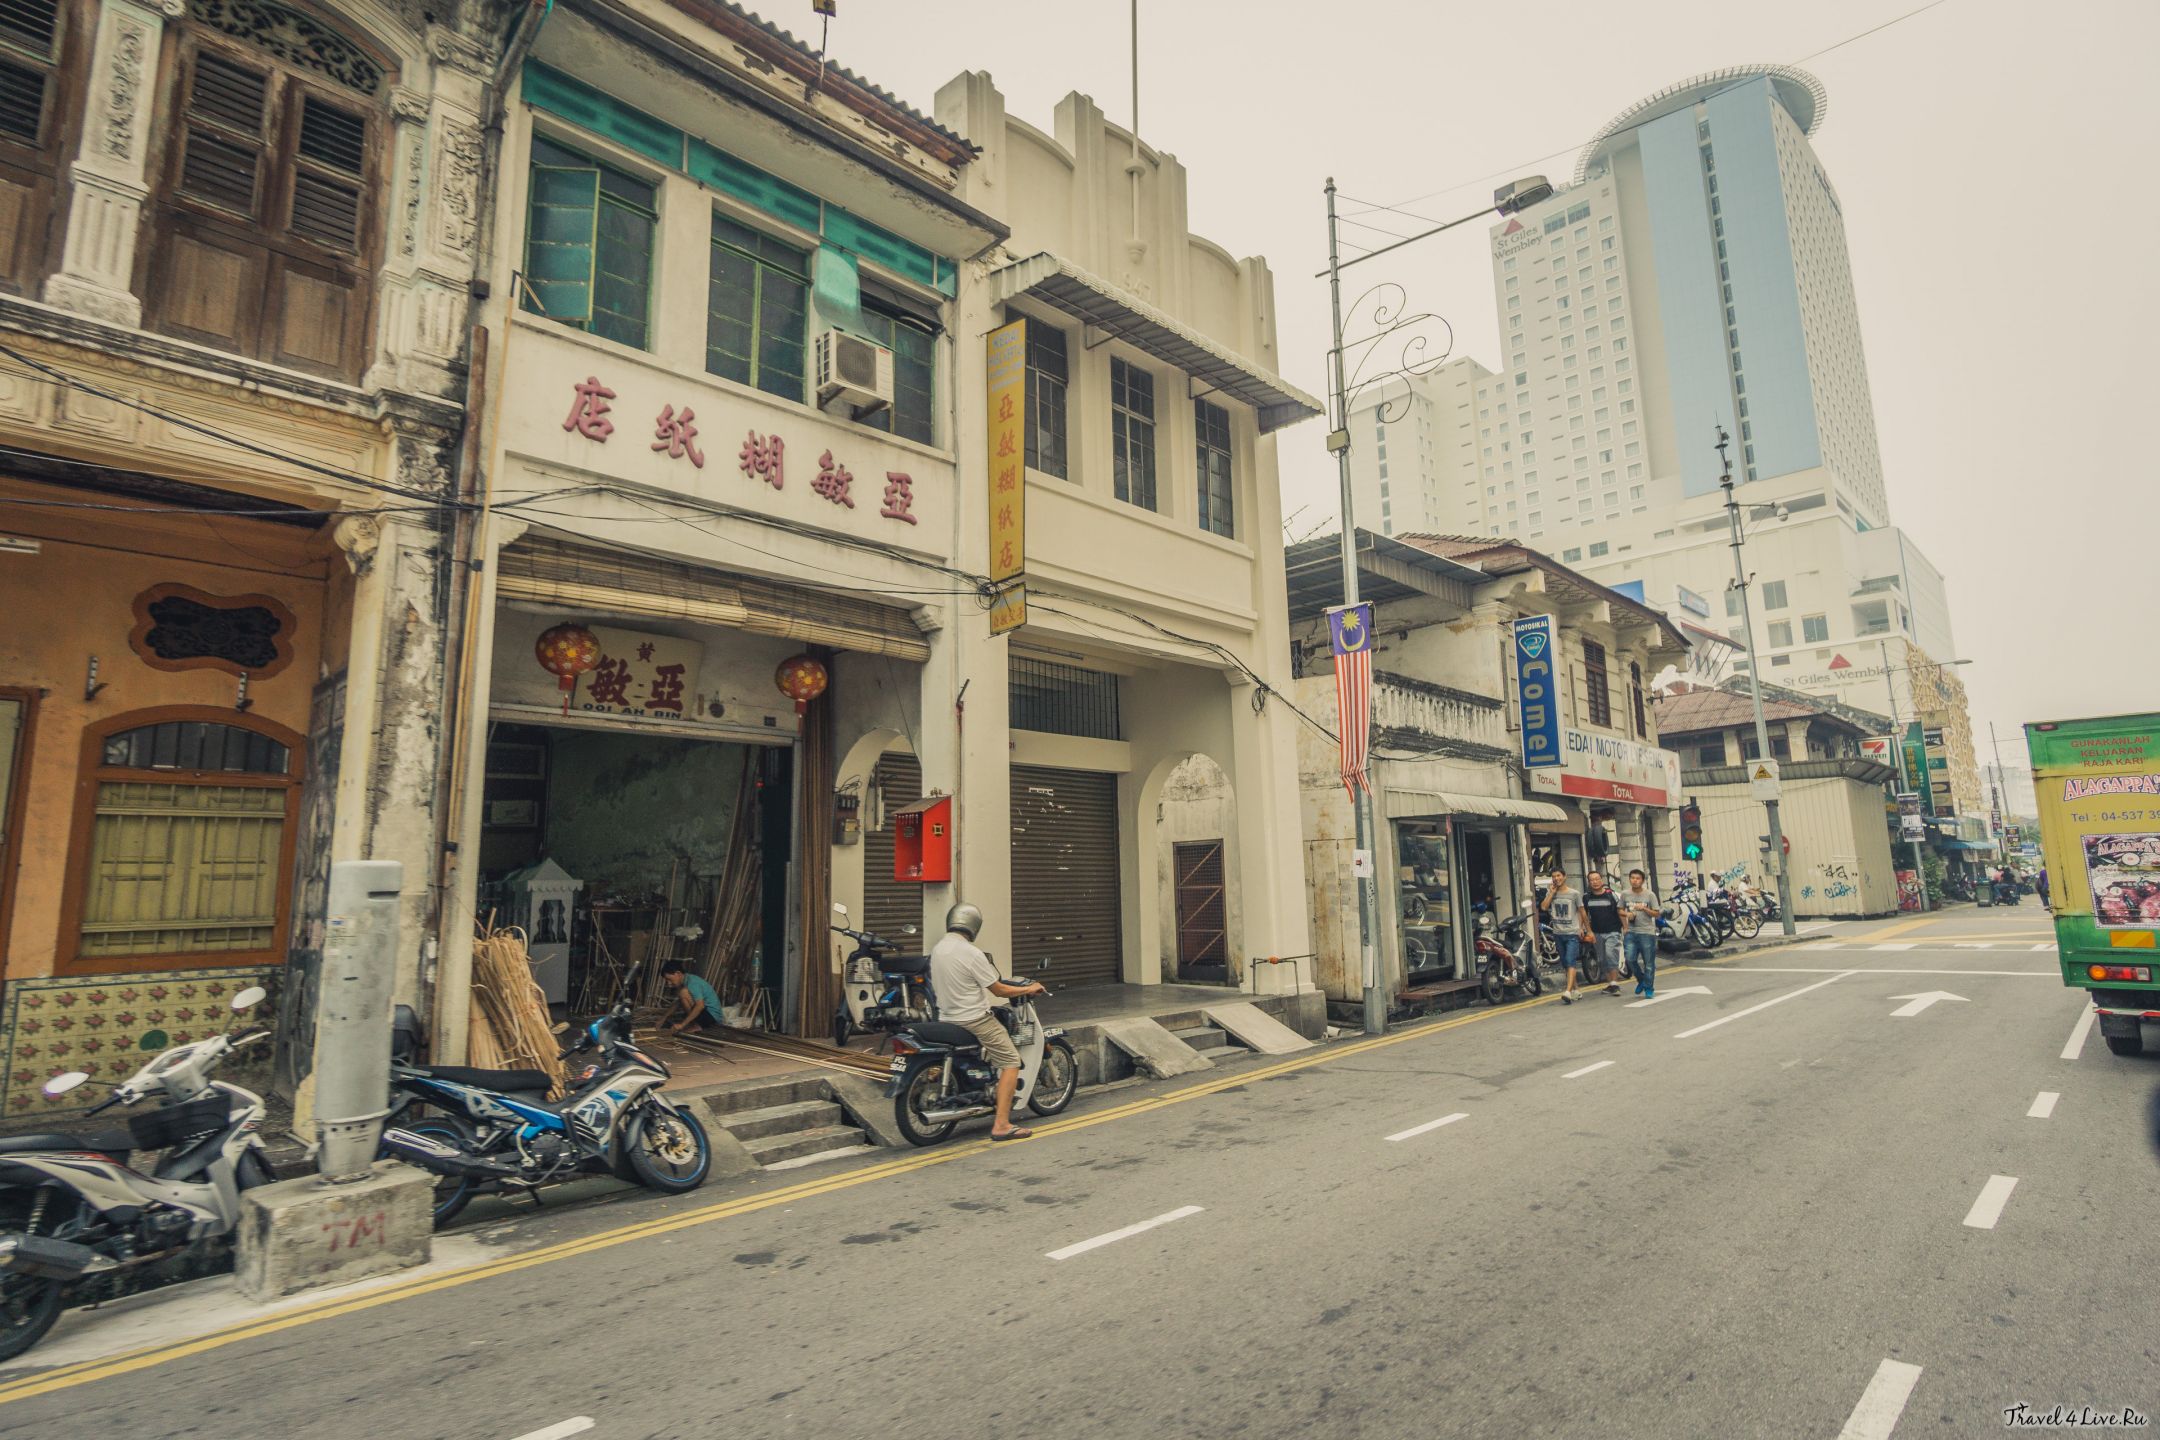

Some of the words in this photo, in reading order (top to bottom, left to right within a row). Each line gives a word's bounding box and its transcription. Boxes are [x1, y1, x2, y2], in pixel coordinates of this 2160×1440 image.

[1494, 235, 1543, 260] Wembley
[1496, 239, 1509, 250] St
[1511, 226, 1538, 244] Giles
[1515, 620, 1548, 632] MOTOSIKAL
[1783, 677, 1796, 687] St
[1798, 674, 1830, 685] Giles
[1835, 665, 1896, 680] Wembley
[583, 703, 612, 712] OOI
[622, 707, 645, 716] AH
[654, 711, 681, 719] BIN
[1523, 660, 1555, 763] Comel
[1596, 737, 1628, 761] MOTOR
[2071, 736, 2151, 748] GUNAKANLAH
[2081, 746, 2144, 757] KELUARAN
[2071, 813, 2089, 822] Tel
[2101, 811, 2143, 821] 04-537
[322, 1212, 385, 1253] TM
